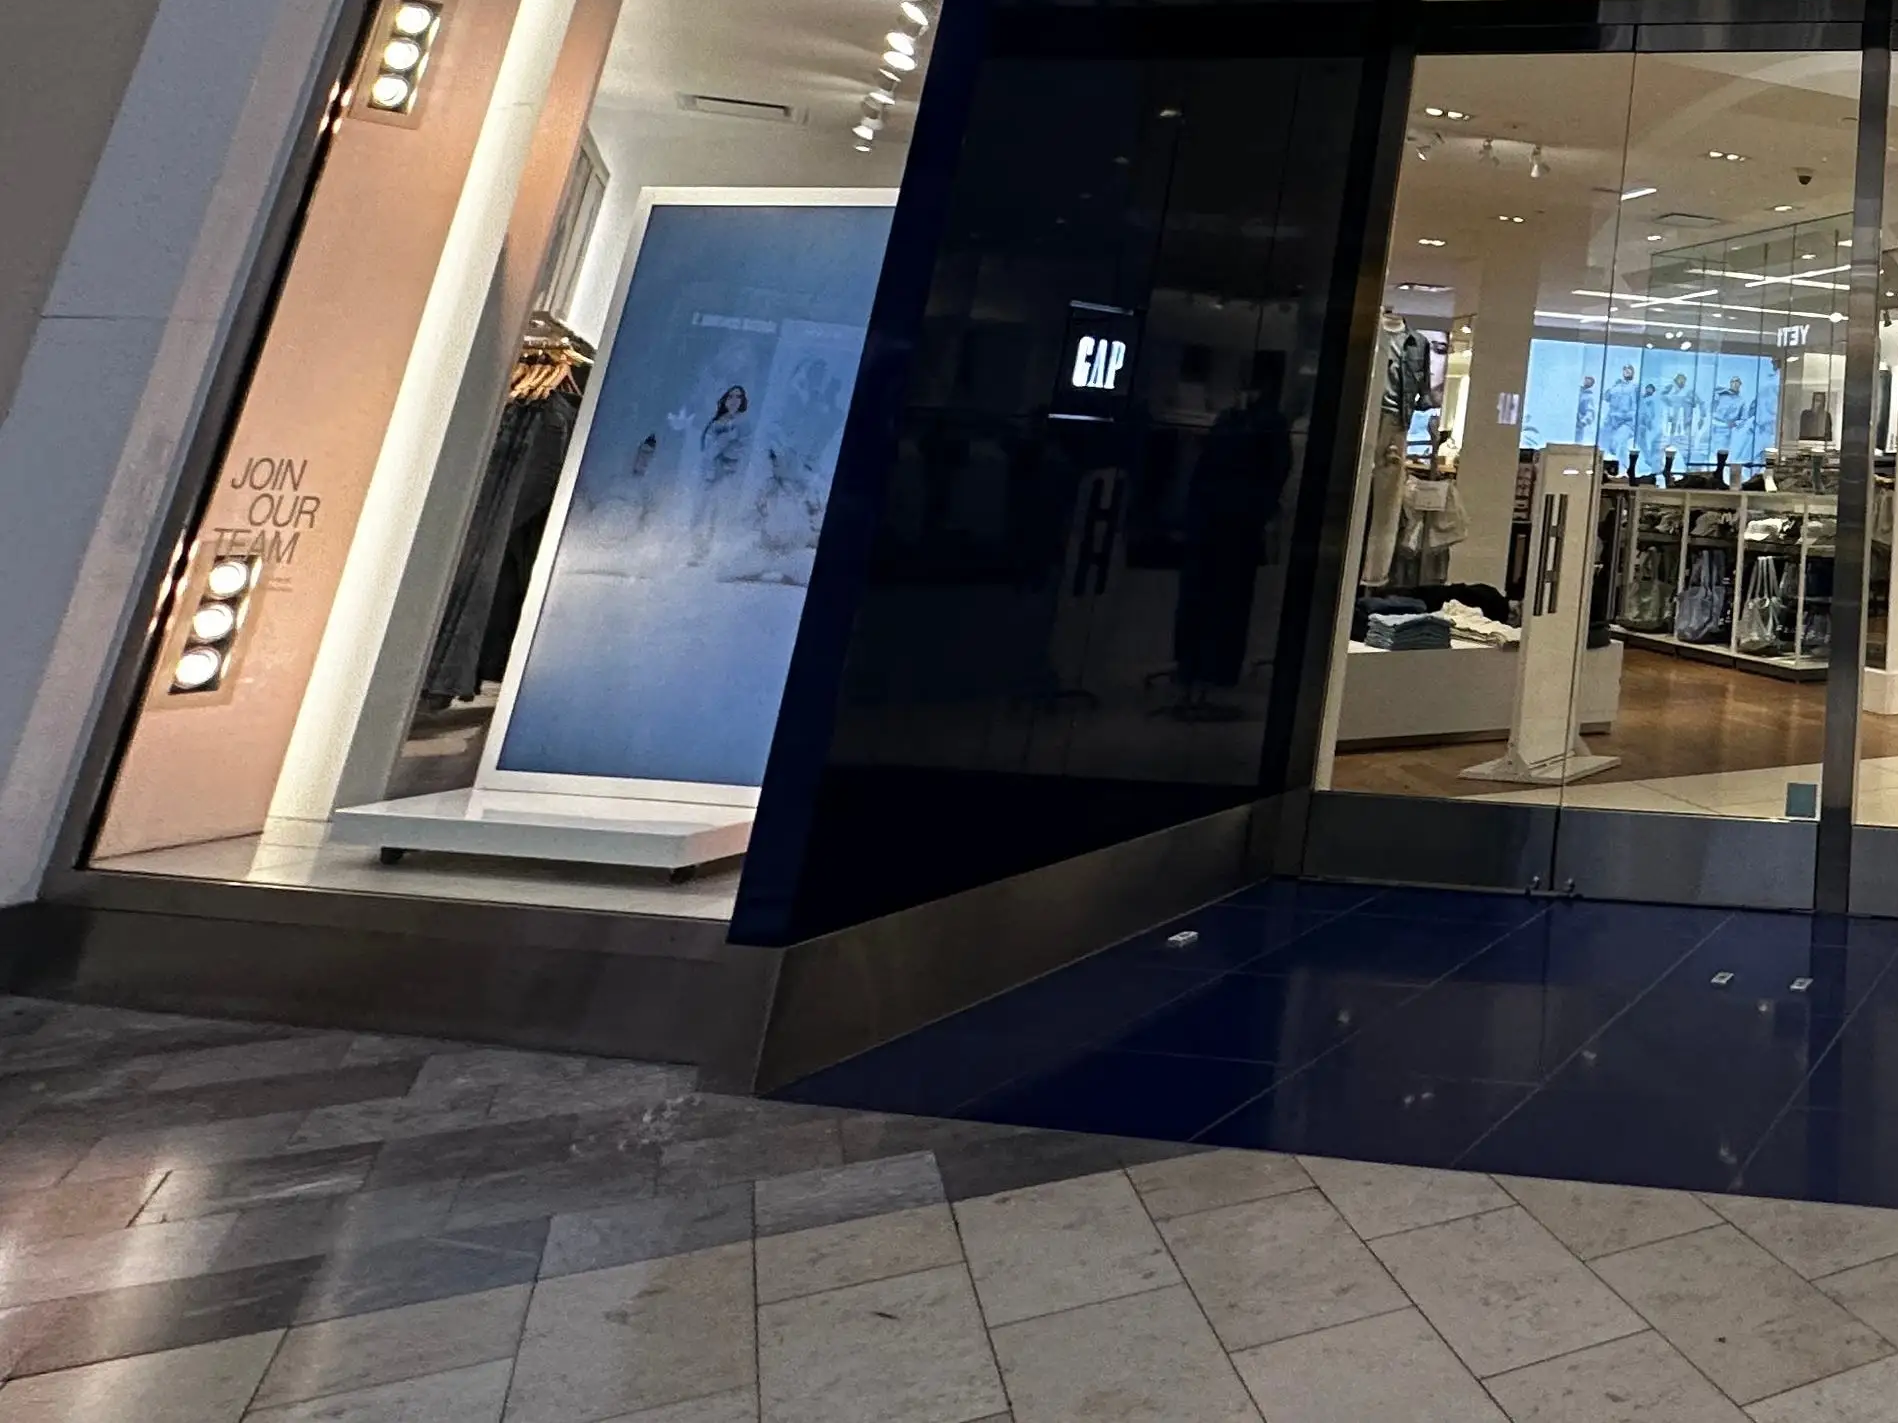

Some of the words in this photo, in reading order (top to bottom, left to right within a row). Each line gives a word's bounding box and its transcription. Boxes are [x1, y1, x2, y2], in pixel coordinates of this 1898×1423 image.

[1073, 336, 1126, 389] GAP
[231, 457, 307, 490] JOIN
[249, 493, 321, 528] OUR
[214, 528, 300, 564] TEAM
